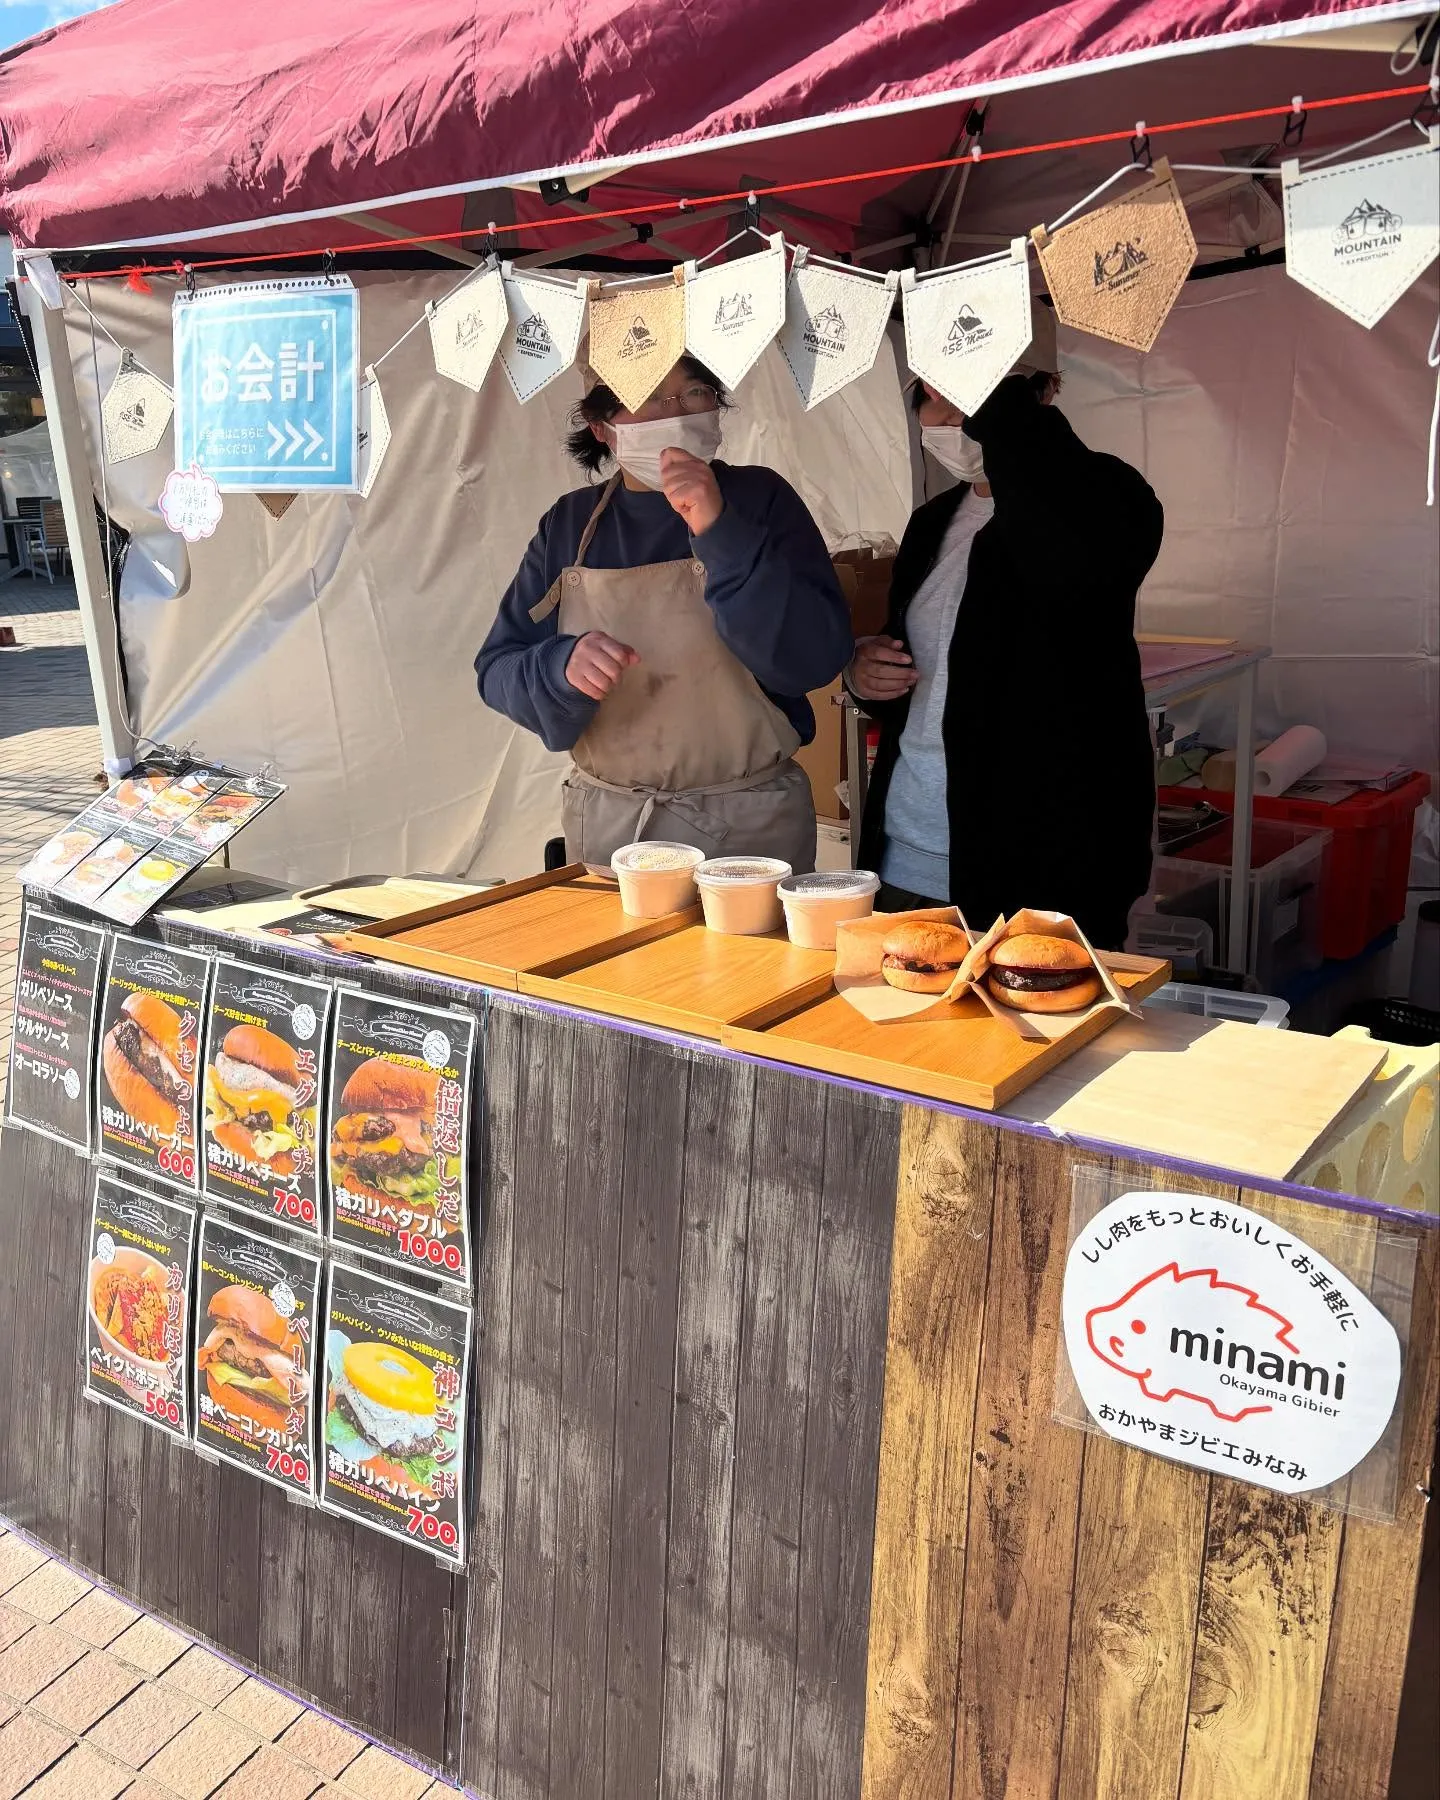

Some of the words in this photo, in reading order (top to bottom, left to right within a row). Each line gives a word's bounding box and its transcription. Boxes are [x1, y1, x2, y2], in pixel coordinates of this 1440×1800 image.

[1334, 233, 1402, 257] MOUNTAIN
[1346, 251, 1389, 265] EXPEDITION
[1108, 271, 1139, 291] Summer
[516, 336, 551, 354] MOUNTAIN
[721, 320, 745, 332] Summer
[803, 332, 846, 353] MOUNTAIN
[942, 341, 963, 357] ISE
[965, 327, 994, 349] Mount
[201, 339, 325, 403] お会計
[17, 1015, 70, 1051] サルサソース
[15, 1052, 66, 1085] オーロラソー
[174, 1010, 197, 1135] クセつよ
[207, 1142, 302, 1194] 猪ガリペチーズ
[433, 1076, 462, 1223] 倍返しだ
[1082, 1207, 1360, 1332] しし肉をもっとおいしくお手軽に
[90, 1346, 170, 1399] ベイクドポテト
[1170, 1326, 1347, 1401] minami
[1219, 1373, 1287, 1403] Okayama
[1291, 1395, 1341, 1418] Gibier
[200, 1393, 310, 1460] 猪ベーコンガリペ
[431, 1361, 460, 1498] 神コンボ
[1098, 1403, 1308, 1481] おかやまジビエみなみ
[328, 1476, 357, 1495] INOSHISHI
[357, 1489, 378, 1504] GARIPE
[329, 1450, 440, 1512] 猪ガリペパイン
